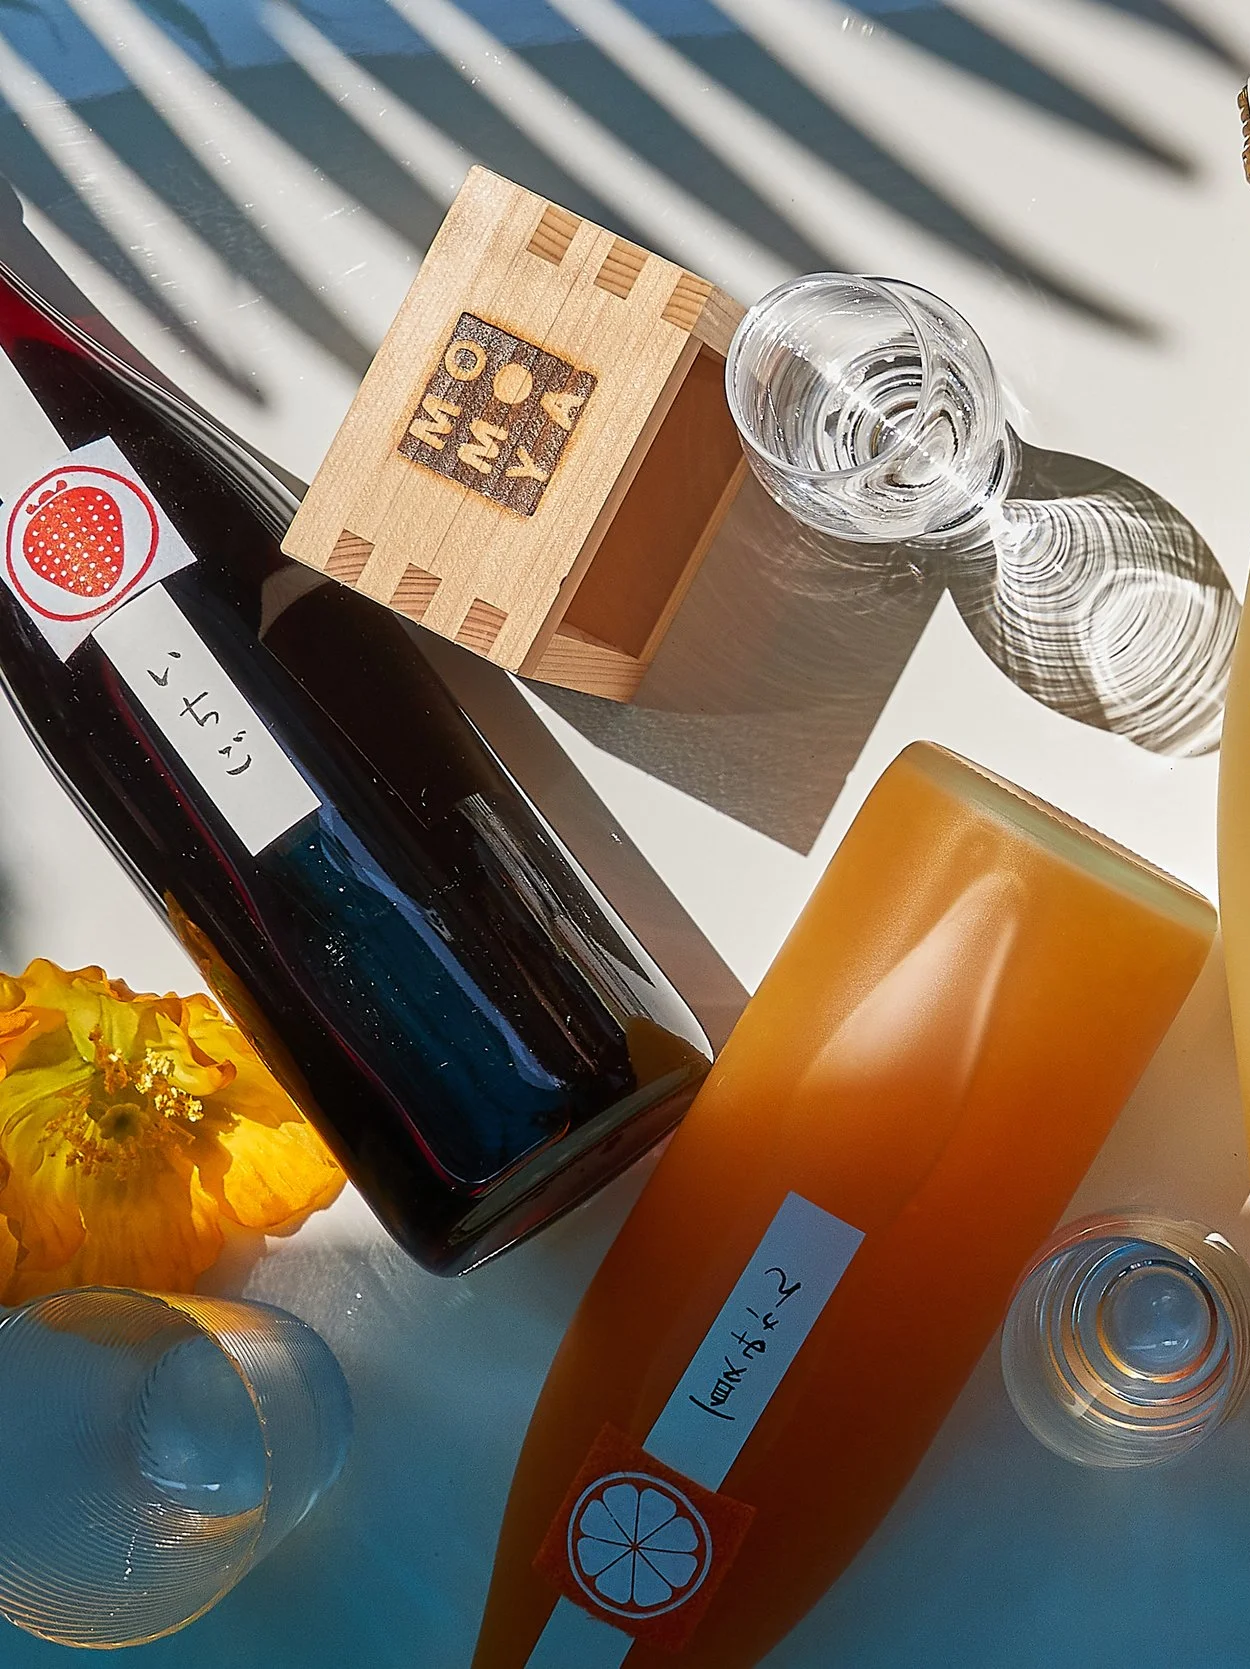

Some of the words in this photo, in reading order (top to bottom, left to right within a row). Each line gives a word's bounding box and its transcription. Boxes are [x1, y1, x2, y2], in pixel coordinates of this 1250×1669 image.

[147, 651, 252, 776] いちご
[688, 1267, 801, 1420] 夏みかん
